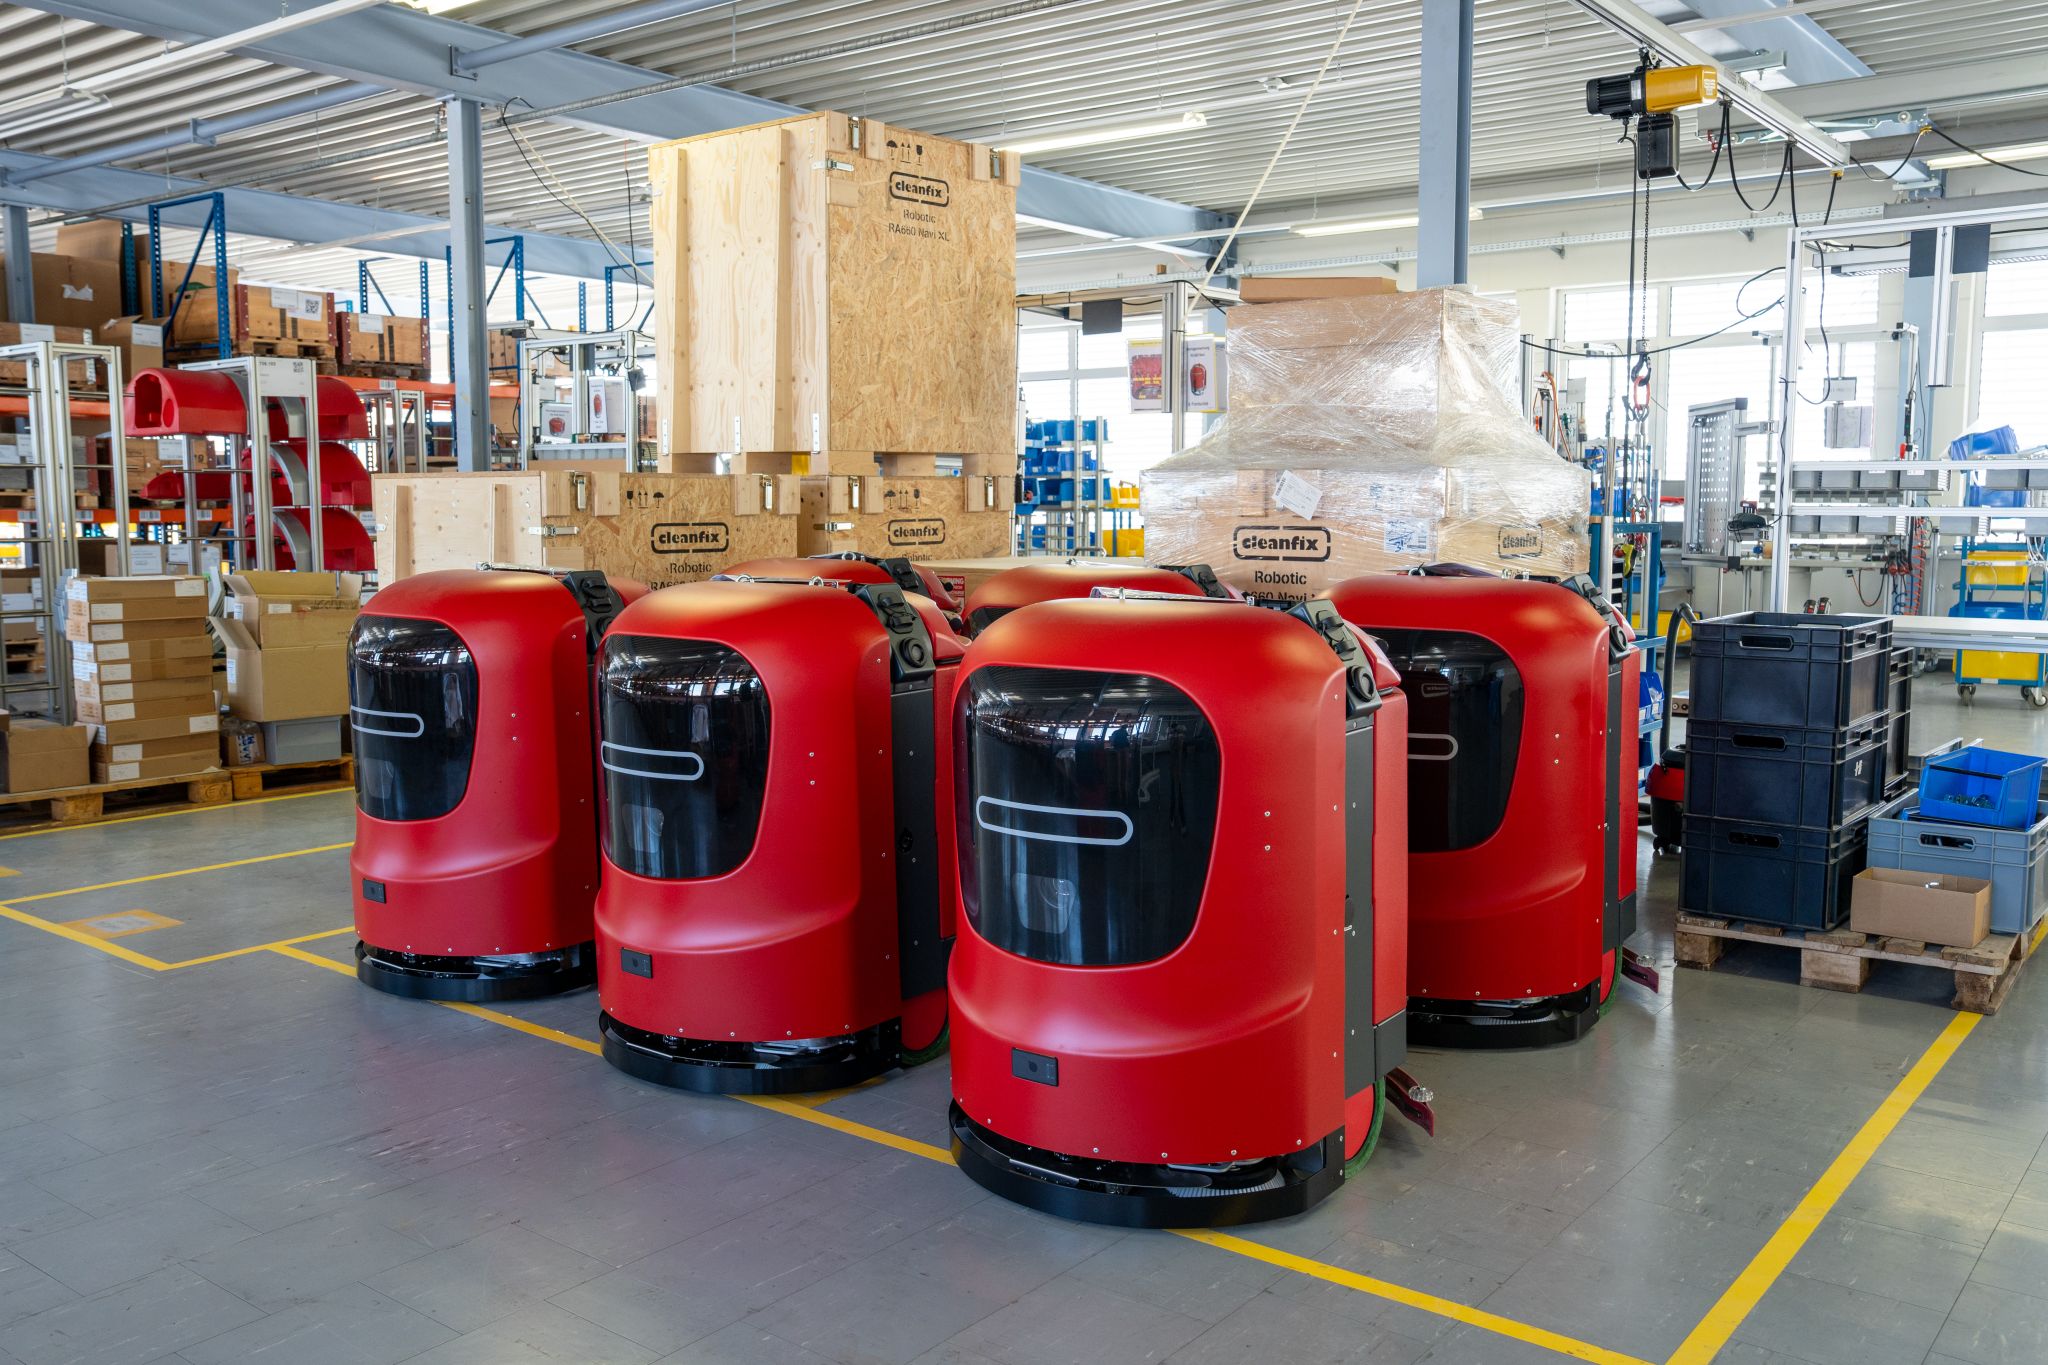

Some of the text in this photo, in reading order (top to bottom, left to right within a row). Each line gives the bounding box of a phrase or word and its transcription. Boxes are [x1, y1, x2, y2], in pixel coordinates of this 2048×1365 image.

[895, 180, 942, 198] cleanfix
[903, 209, 936, 223] Robotic
[888, 222, 950, 242] RA660 Navi XL
[659, 531, 720, 544] cleanfix
[893, 526, 939, 538] cleanfix
[1242, 535, 1319, 551] cleanfix
[1502, 533, 1538, 549] cleanfix
[670, 562, 712, 574] Robotic
[1255, 571, 1307, 585] Robotic
